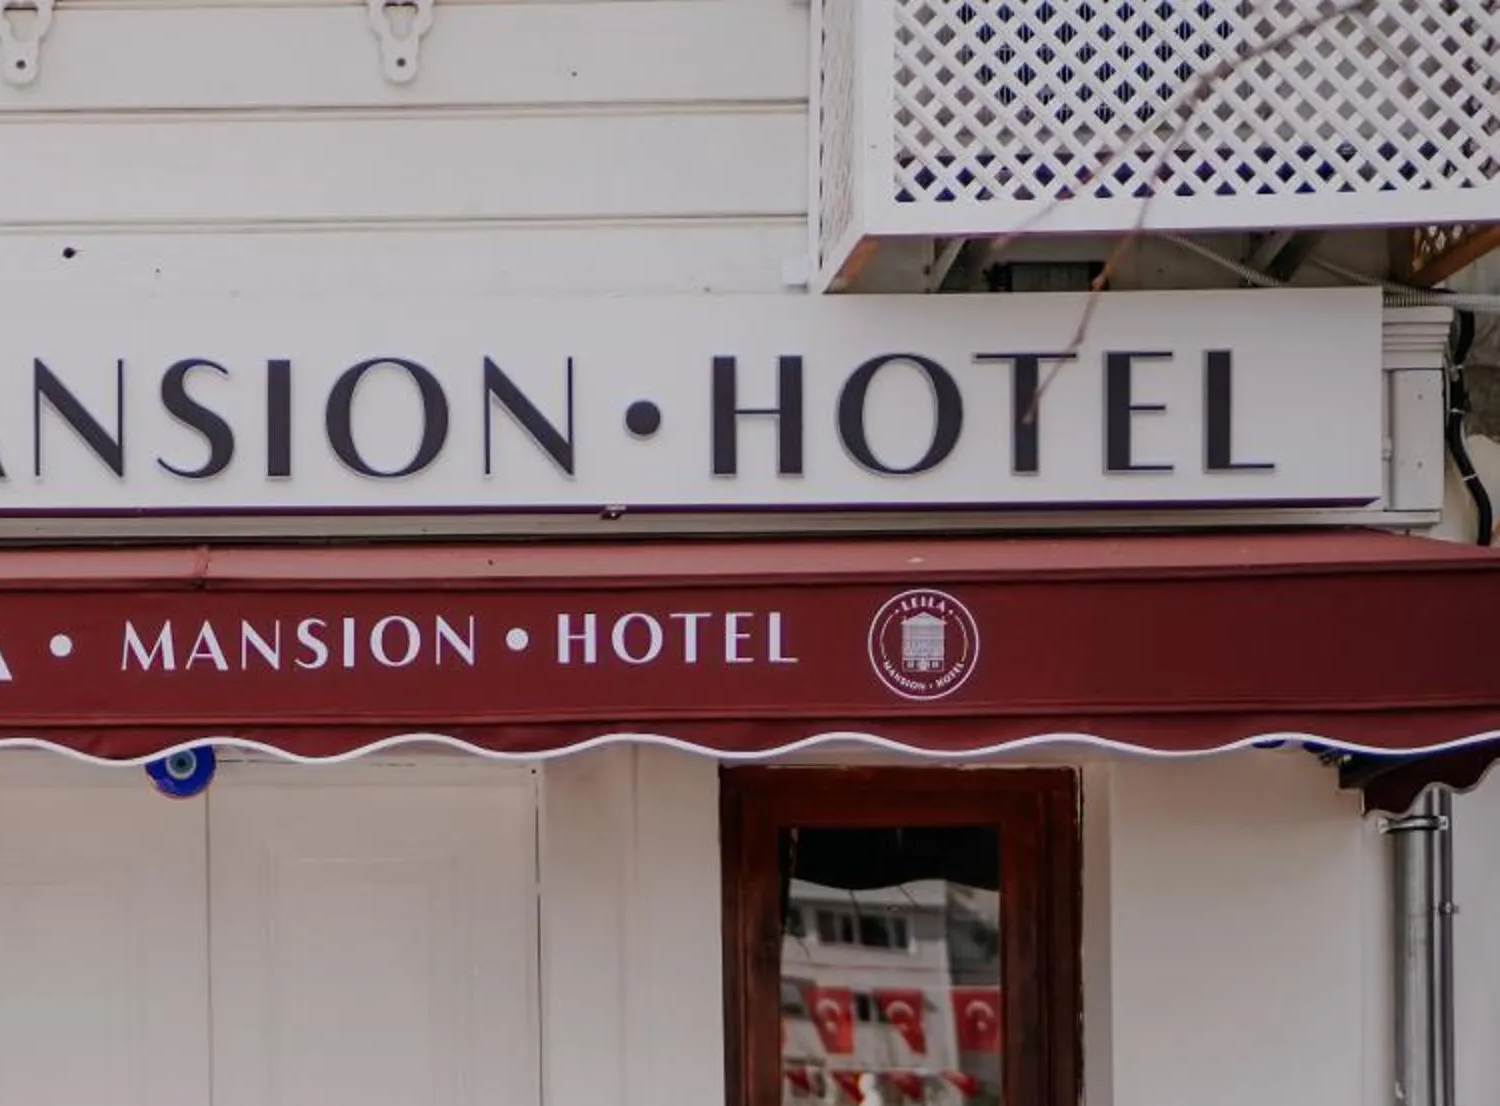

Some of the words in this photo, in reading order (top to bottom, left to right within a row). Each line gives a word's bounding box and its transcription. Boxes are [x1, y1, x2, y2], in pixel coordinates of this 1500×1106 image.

[711, 348, 1276, 477] HOTEL
[121, 615, 475, 671] MANSION
[558, 612, 799, 664] HOTEL
